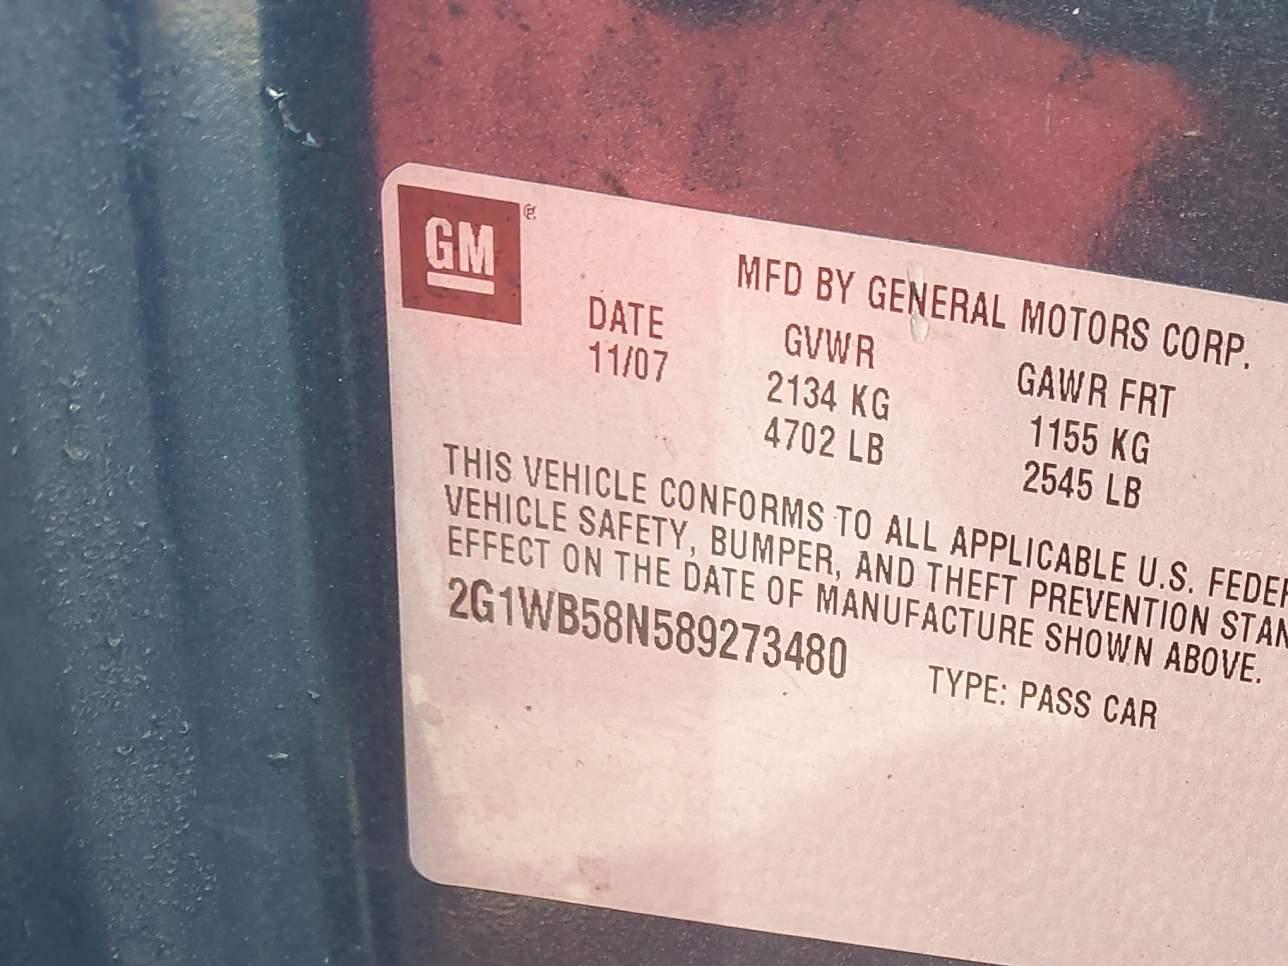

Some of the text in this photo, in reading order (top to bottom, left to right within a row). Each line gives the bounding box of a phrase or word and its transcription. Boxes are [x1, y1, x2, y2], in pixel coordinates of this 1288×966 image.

[425, 216, 495, 276] GM
[588, 296, 664, 339] DATE
[737, 254, 1251, 370] MFD BY GENERAL MOTORS CORP.
[588, 341, 668, 383] 11/07
[784, 324, 875, 369] GVWR
[767, 370, 889, 420] 2134 KG
[1016, 363, 1175, 419] GAWR FRT
[763, 417, 884, 465] 4702 LB
[1030, 415, 1150, 465] 1155 KG
[1022, 461, 1142, 509] 2545 LB
[443, 443, 511, 484] THIS
[524, 455, 646, 504] VEHICLE
[661, 477, 823, 532] CONFORMS
[835, 505, 870, 539] TO
[885, 515, 937, 553] ALL
[950, 526, 1125, 583] APPLICABLE
[1138, 555, 1193, 595] U.S.
[445, 485, 566, 532] VEHICLE
[579, 505, 696, 556] SAFETY,
[711, 525, 840, 580] BUMPER,
[856, 550, 915, 588] AND
[927, 562, 1018, 602] THEFT
[1030, 583, 1207, 635] PREVENTION
[448, 526, 1261, 684] EFFECT ON THE DATE OF MANUFACTURE SHOWN ABOVE.
[448, 577, 847, 679] 2G1WB58N589273480
[929, 666, 1158, 730] TYPE: PASS CAR
